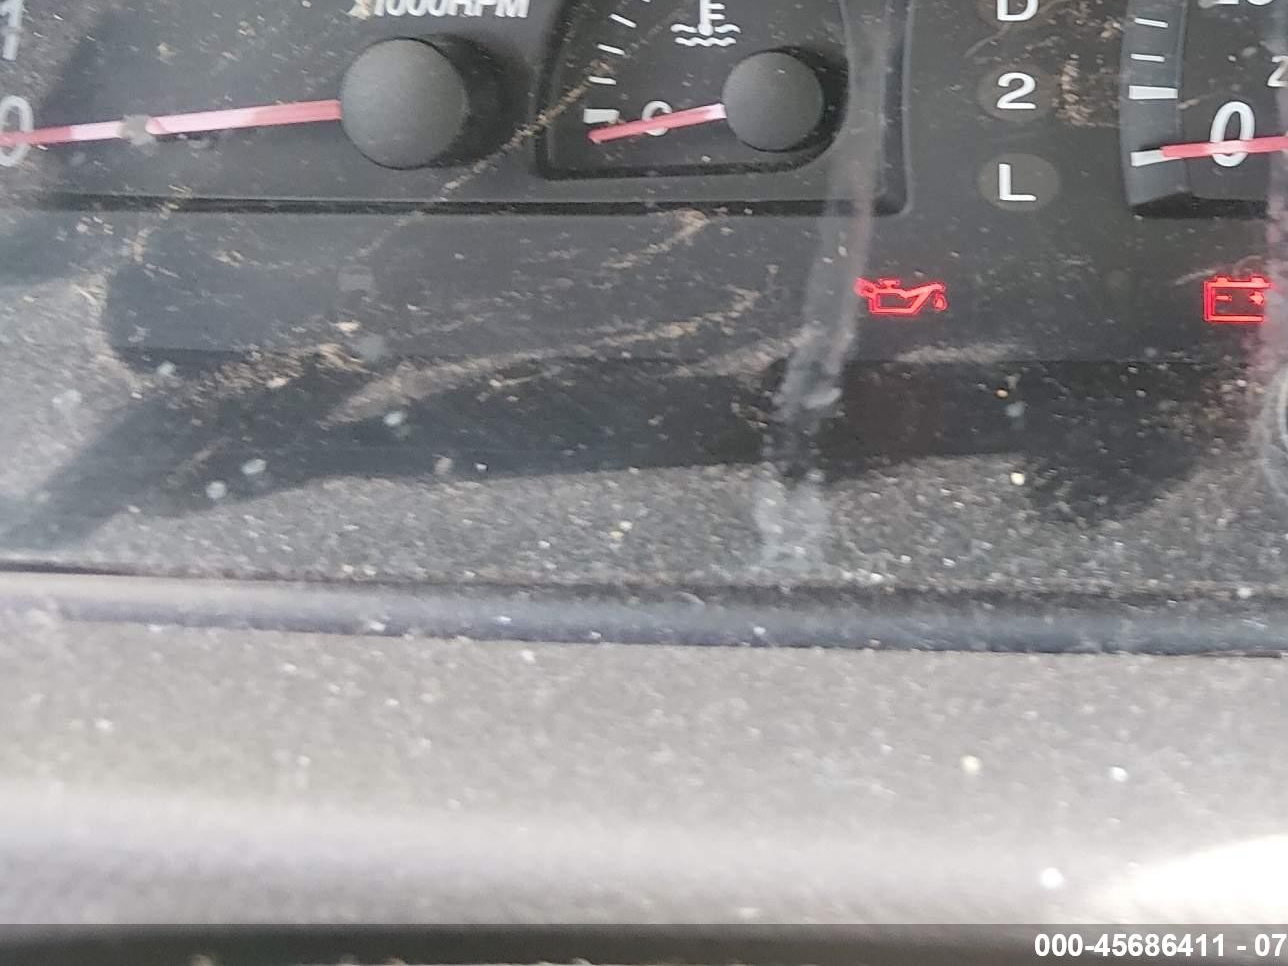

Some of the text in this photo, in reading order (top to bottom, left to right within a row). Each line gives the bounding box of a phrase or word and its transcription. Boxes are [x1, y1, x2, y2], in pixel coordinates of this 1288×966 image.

[997, 72, 1036, 109] 2
[0, 95, 34, 166] 0
[1209, 101, 1255, 167] 0
[999, 164, 1036, 201] L
